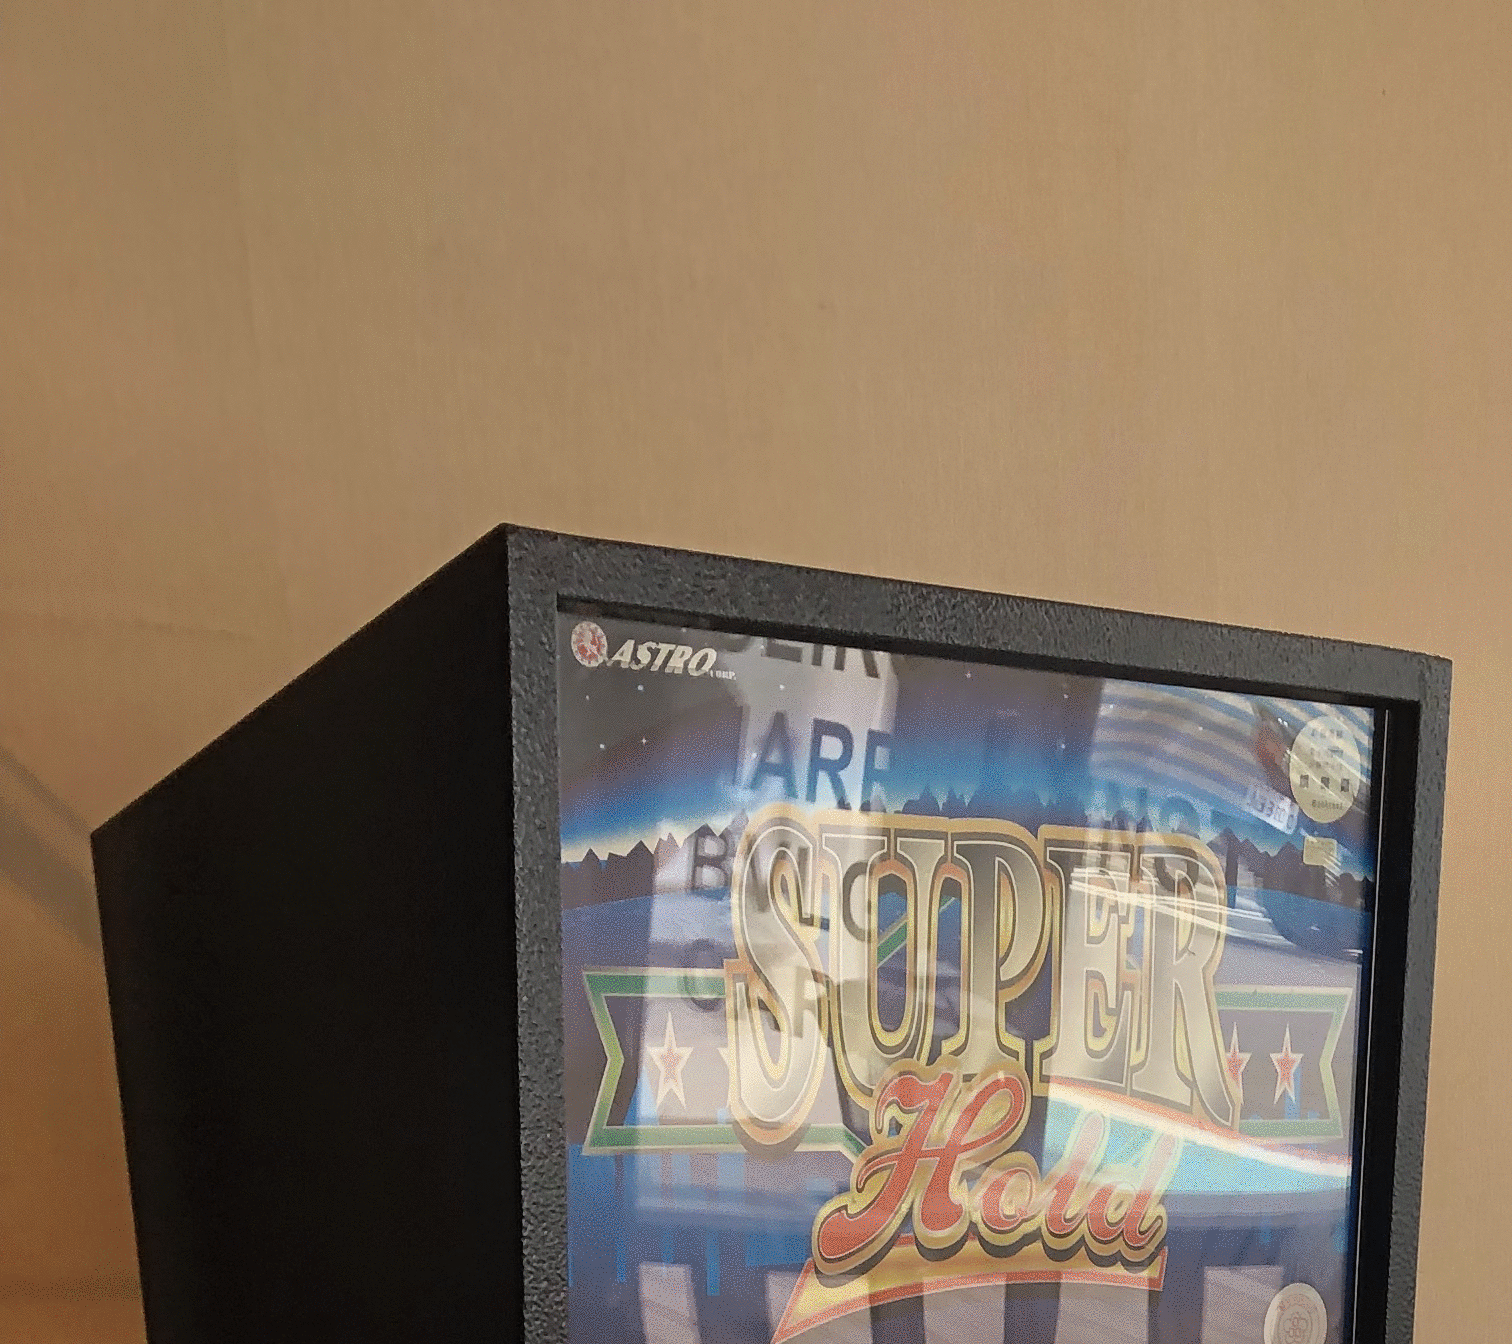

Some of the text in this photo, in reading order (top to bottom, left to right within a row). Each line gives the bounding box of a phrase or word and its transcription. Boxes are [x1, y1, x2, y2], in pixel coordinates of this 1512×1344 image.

[606, 639, 717, 676] ASTRO
[731, 806, 1243, 1146] SUPER
[812, 1060, 1180, 1284] Hold
